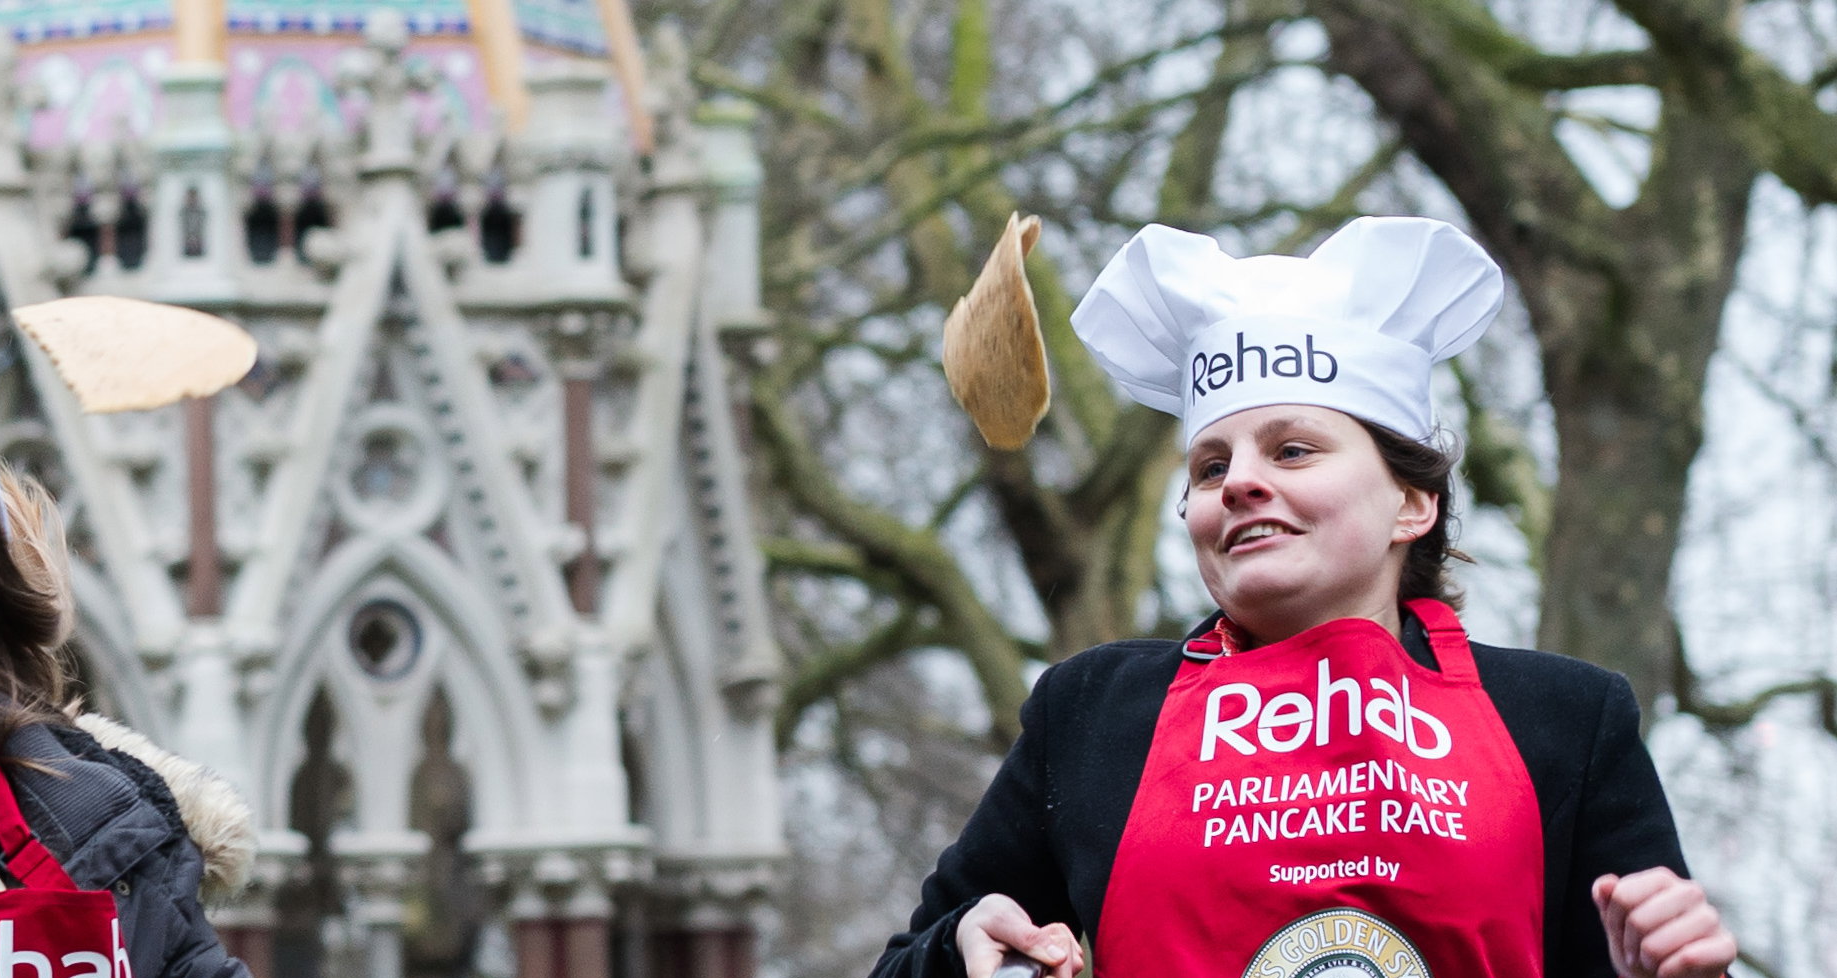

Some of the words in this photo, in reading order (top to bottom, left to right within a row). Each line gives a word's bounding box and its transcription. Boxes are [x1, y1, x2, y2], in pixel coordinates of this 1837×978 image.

[1192, 331, 1338, 407] Rehab
[1199, 657, 1453, 762] Rehab
[1192, 759, 1469, 813] PARLIAMENTARY
[1204, 801, 1367, 848] PANCAKE
[1380, 799, 1467, 841] RACE
[1269, 856, 1370, 884] Supported
[1374, 856, 1401, 882] by
[1279, 918, 1390, 964] GOLDEN
